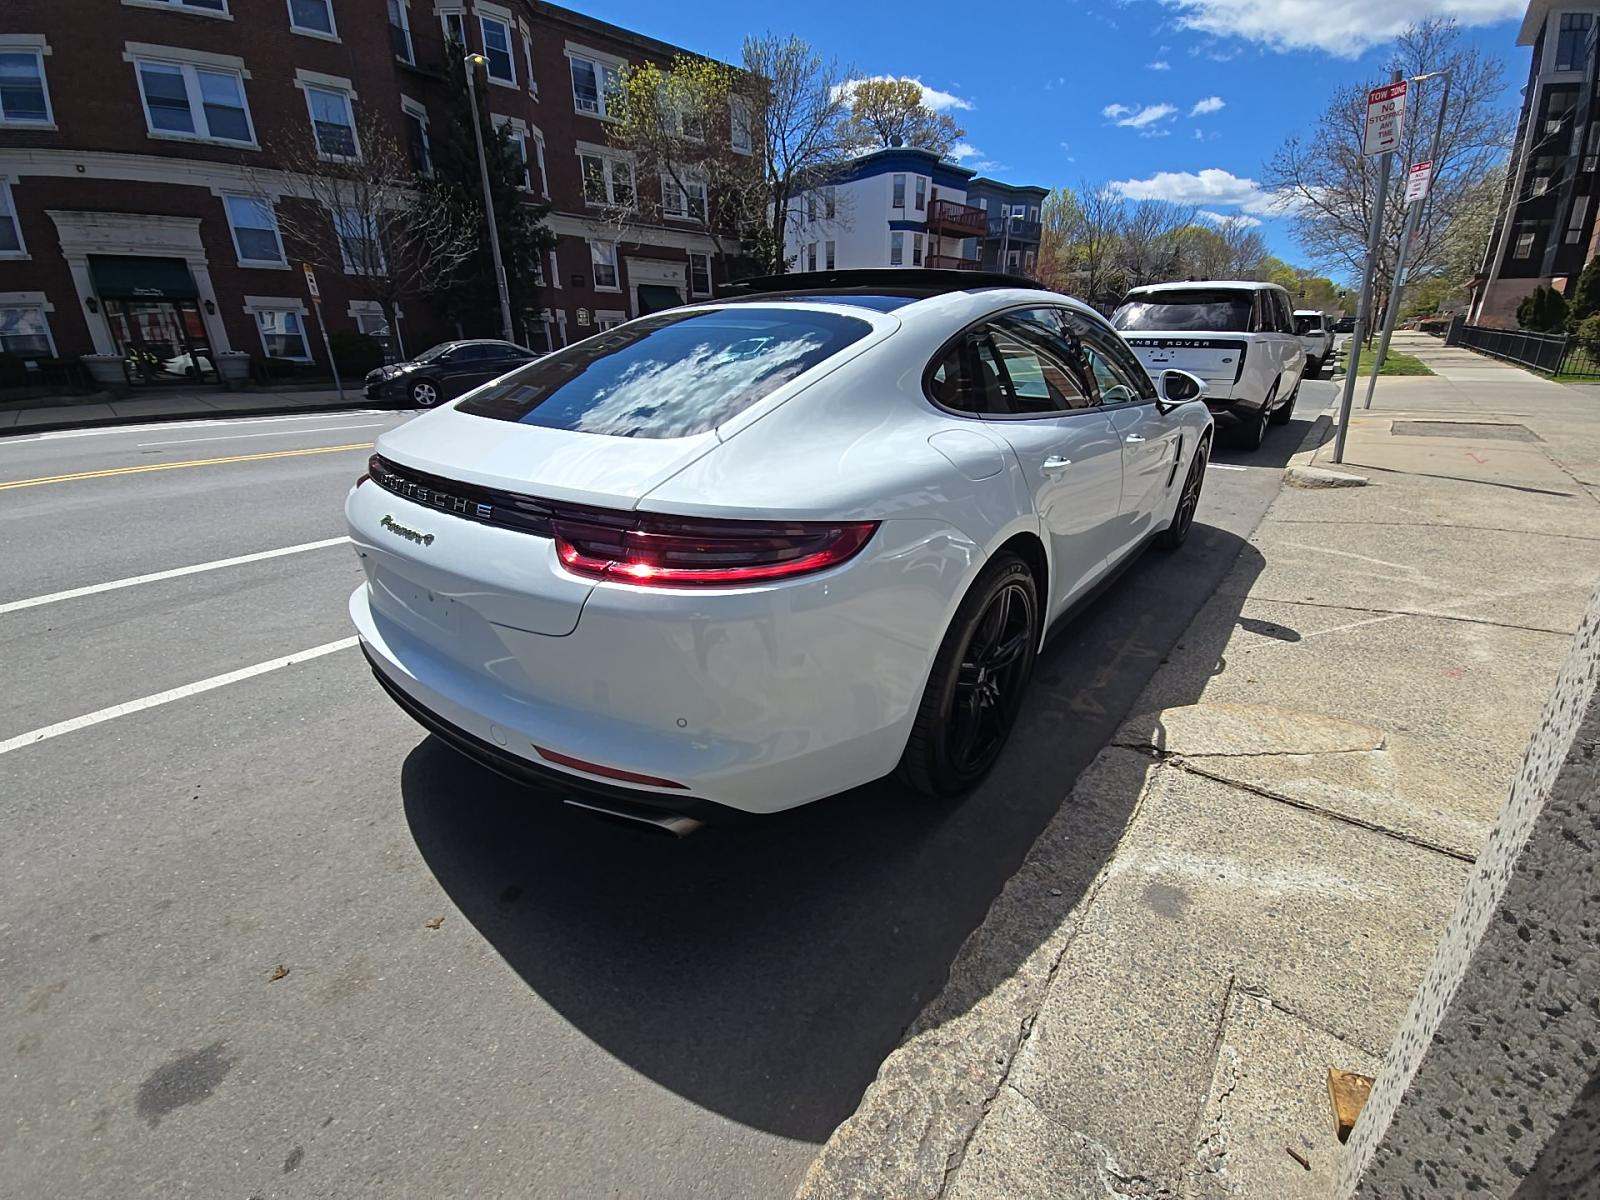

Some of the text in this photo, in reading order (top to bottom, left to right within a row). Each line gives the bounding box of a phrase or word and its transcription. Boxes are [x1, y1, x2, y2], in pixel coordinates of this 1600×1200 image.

[1370, 85, 1406, 101] TOW ZONE
[1381, 103, 1395, 113] NO
[1369, 109, 1403, 124] STOPPING
[1379, 121, 1393, 130] ANY
[1378, 129, 1393, 138] TIME
